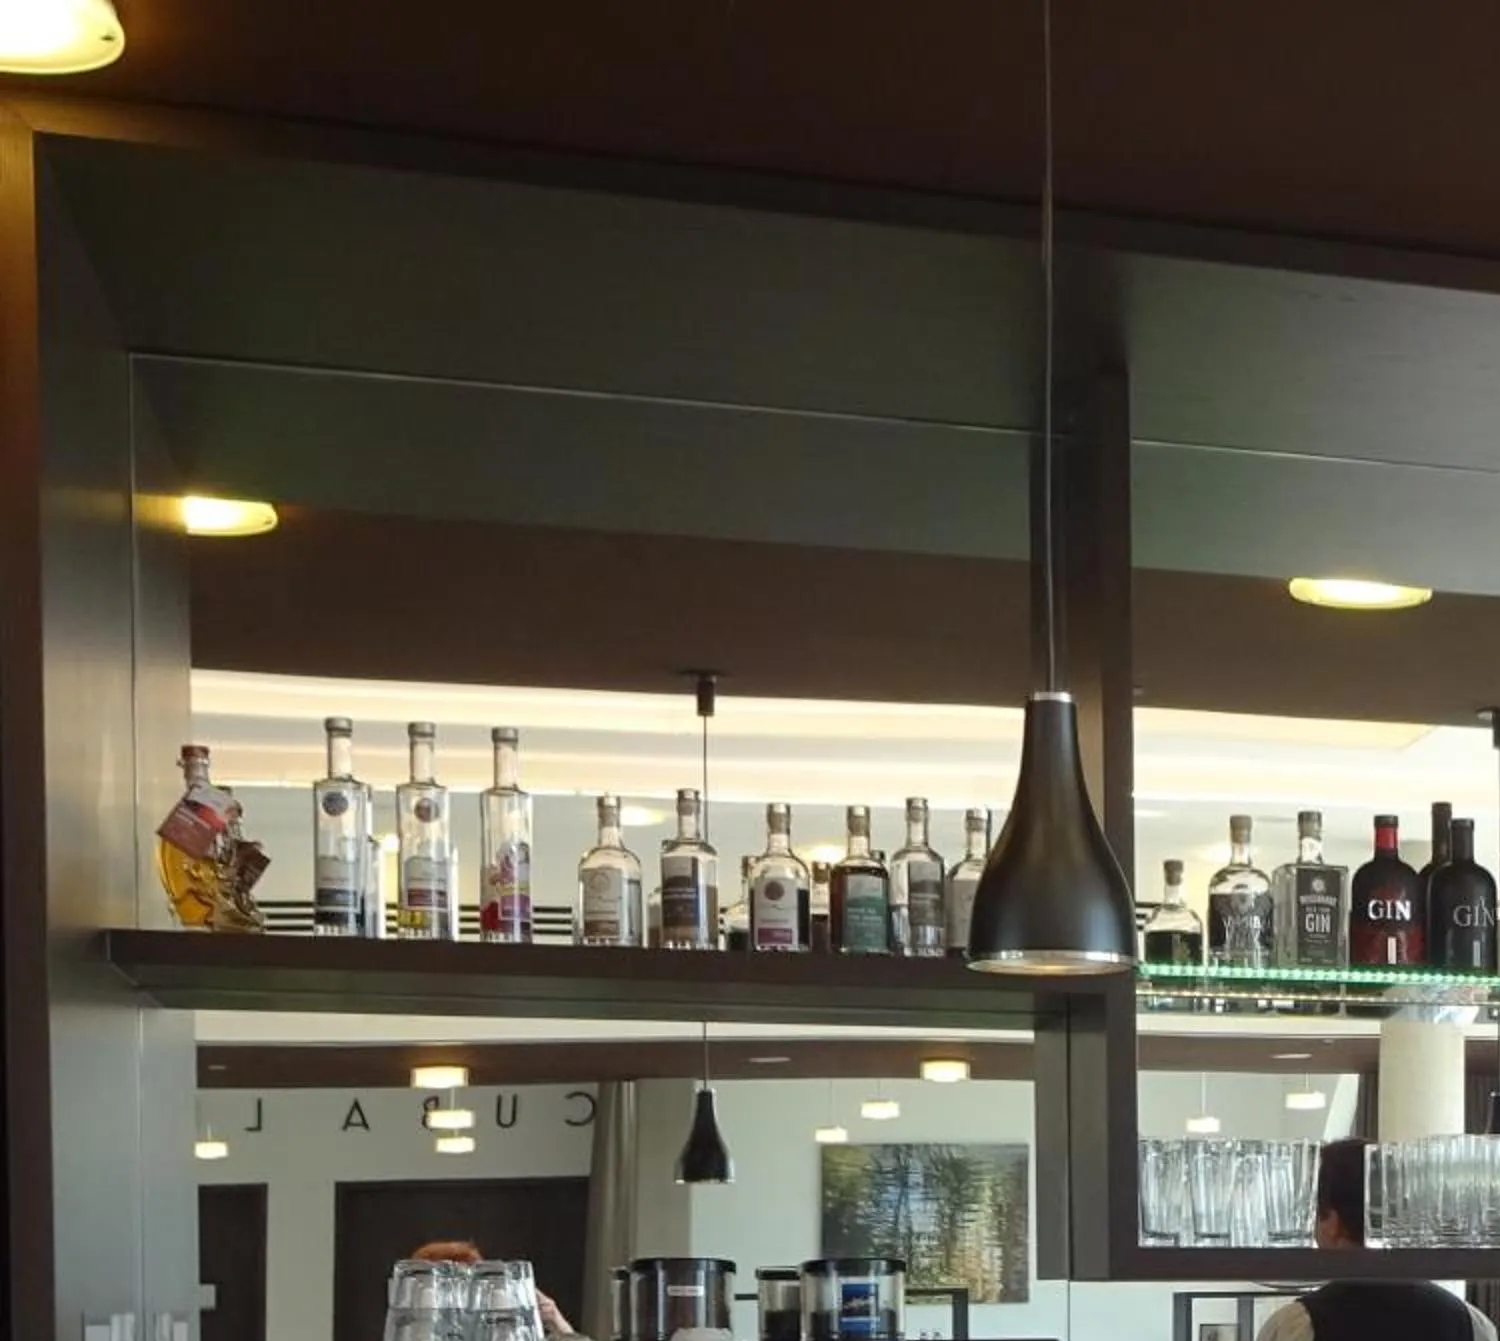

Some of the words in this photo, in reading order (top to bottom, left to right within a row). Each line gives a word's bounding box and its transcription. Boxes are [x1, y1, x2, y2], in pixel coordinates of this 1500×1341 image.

[1367, 899, 1412, 921] GIN
[1453, 905, 1496, 928] GIN
[1305, 913, 1331, 933] GIN
